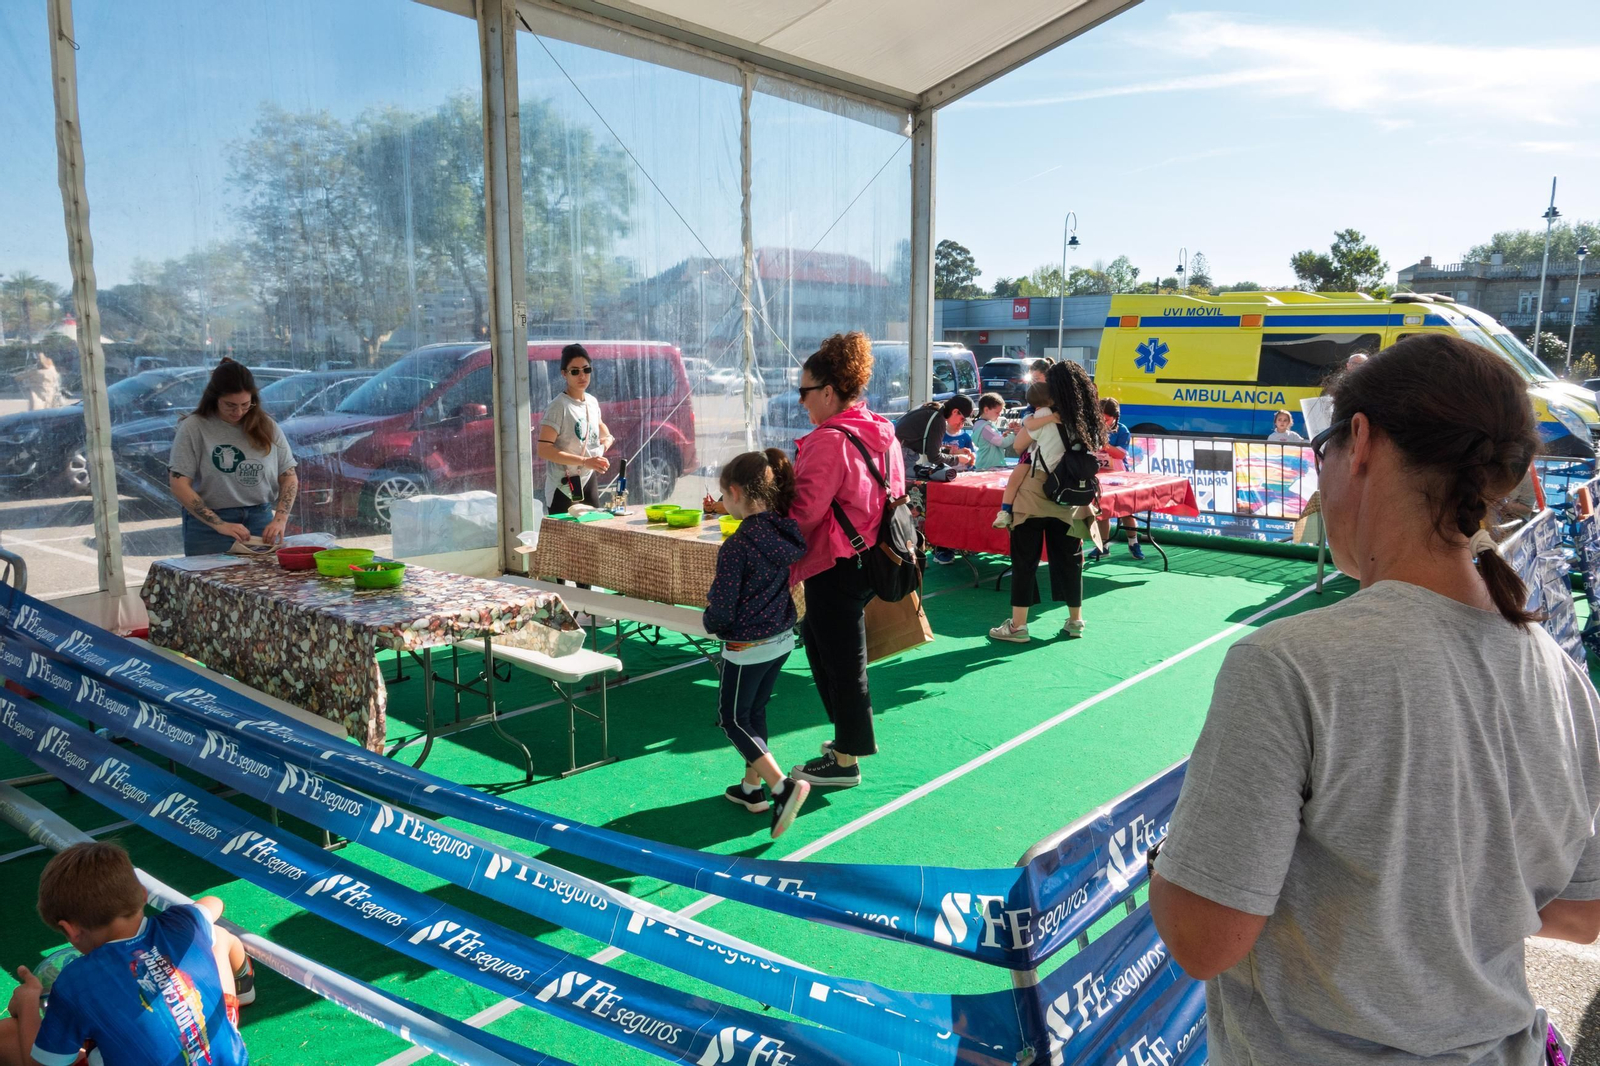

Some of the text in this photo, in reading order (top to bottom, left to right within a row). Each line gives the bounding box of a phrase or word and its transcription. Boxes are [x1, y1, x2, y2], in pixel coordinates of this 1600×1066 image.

[1164, 306, 1224, 316] UVI MÓVIL
[1172, 388, 1286, 404] AMBULANCIA
[23, 607, 42, 633] FE
[35, 626, 58, 641] seguros
[69, 634, 110, 666] FE seguros
[38, 655, 72, 692] FE seguros
[89, 678, 130, 717] FE seguros
[2, 702, 36, 740] FE seguros
[148, 704, 196, 746] FE seguros
[50, 731, 90, 771] FE seguros
[218, 734, 272, 778] FE seguros
[104, 762, 151, 804] FE seguros
[299, 768, 364, 817] FE seguros
[168, 798, 222, 840] FE seguros
[242, 837, 307, 880] FE seguros
[424, 829, 474, 860] seguros
[332, 881, 408, 927] FE seguros
[976, 882, 1088, 950] FE seguros
[439, 928, 530, 981] FE seguros
[140, 952, 180, 1004] CARREIRA
[1073, 972, 1114, 1033] FE
[1112, 943, 1166, 1003] seguros
[573, 980, 682, 1045] FE seguros
